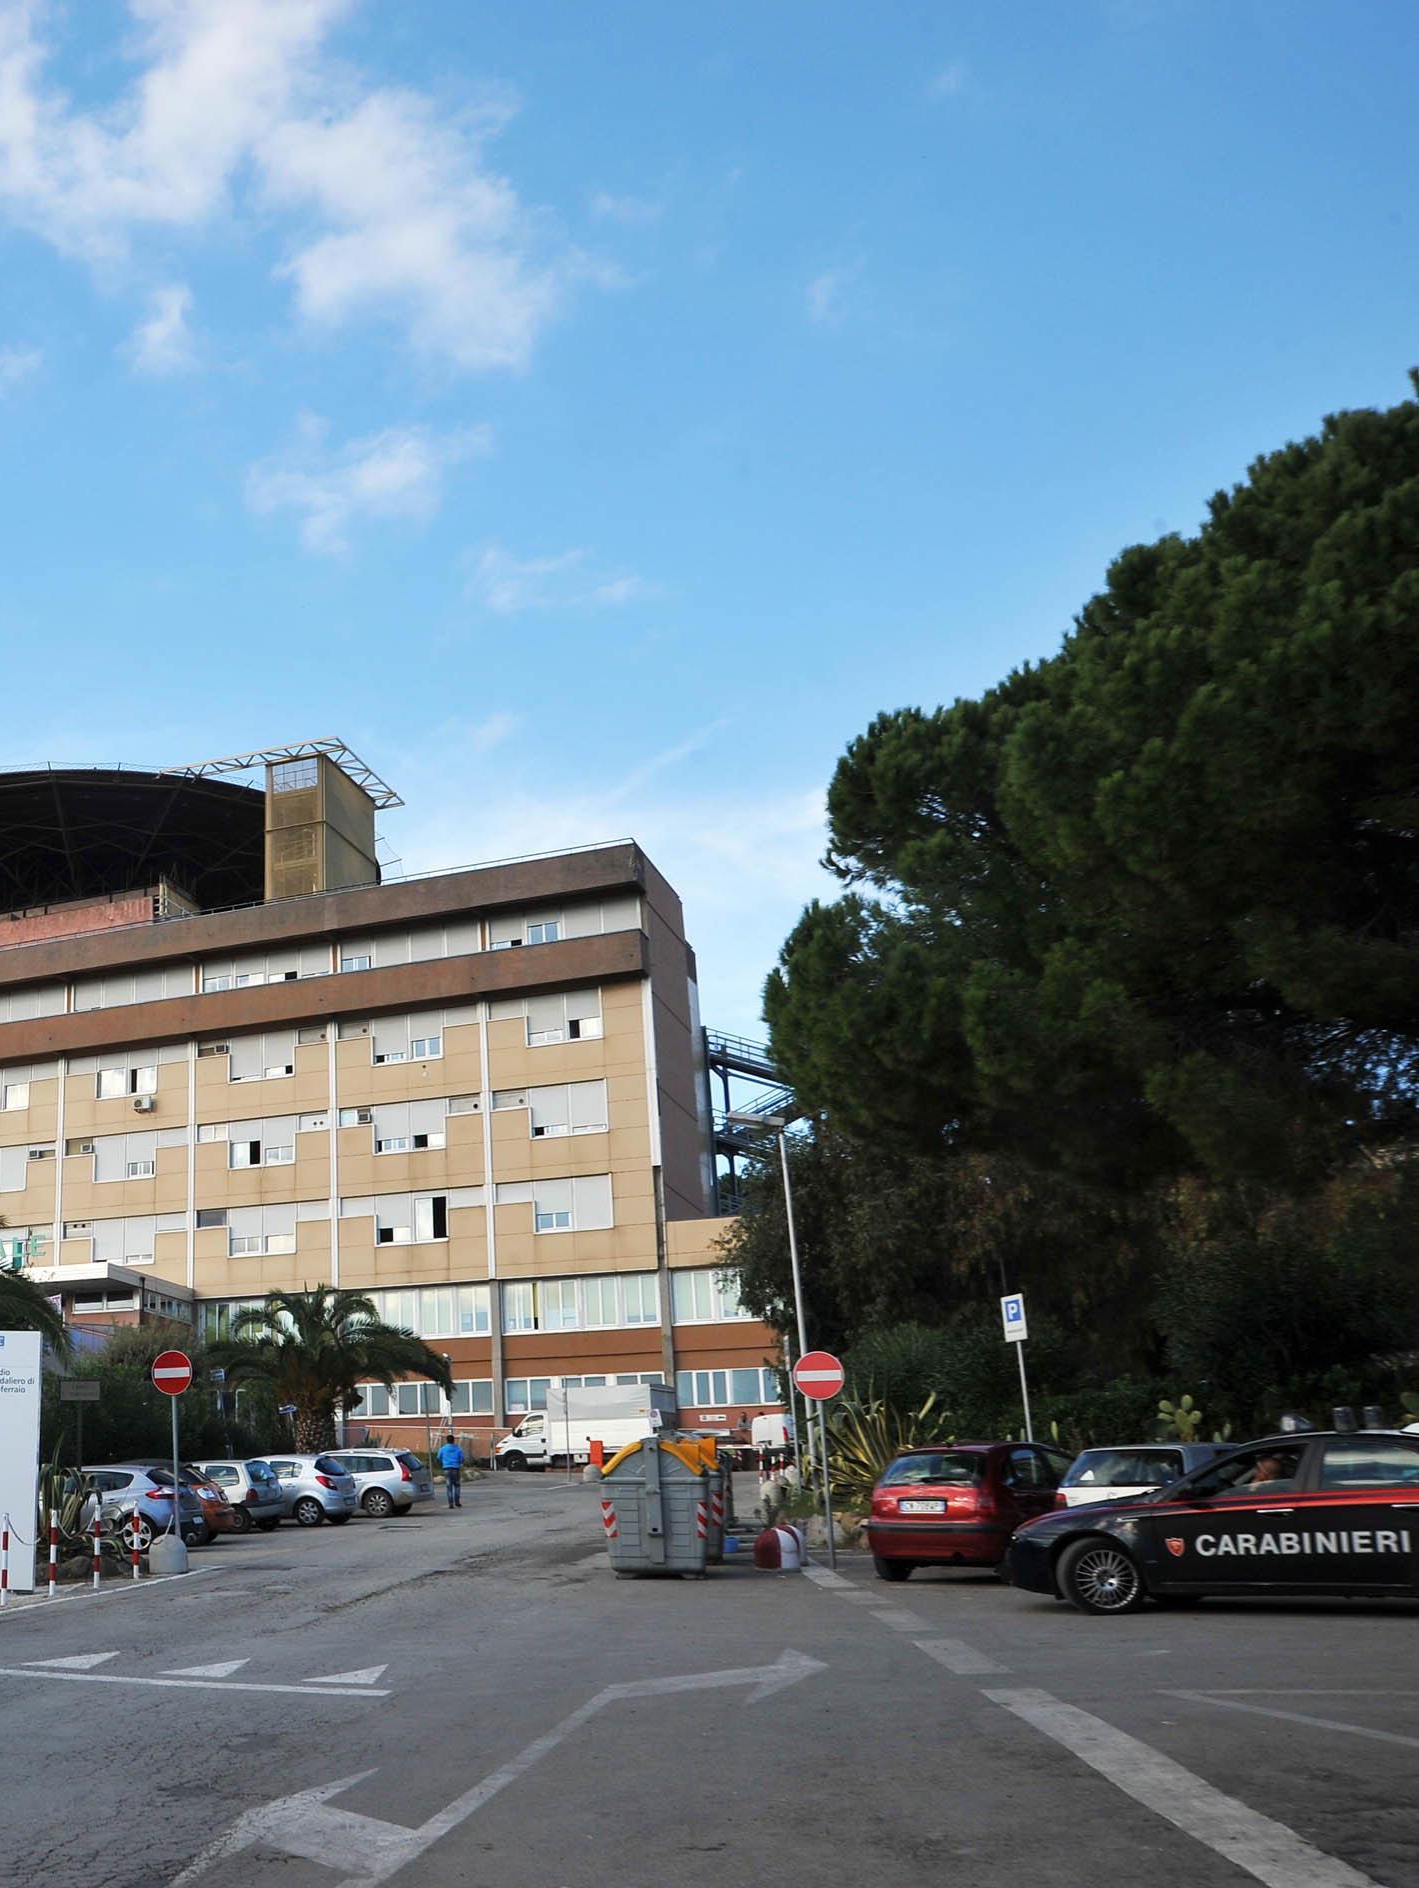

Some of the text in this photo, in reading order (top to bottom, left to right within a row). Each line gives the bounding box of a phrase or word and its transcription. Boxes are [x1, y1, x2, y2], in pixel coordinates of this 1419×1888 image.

[1007, 1303, 1018, 1320] P
[27, 1377, 35, 1385] di
[1194, 1531, 1411, 1556] CARABINIERI
